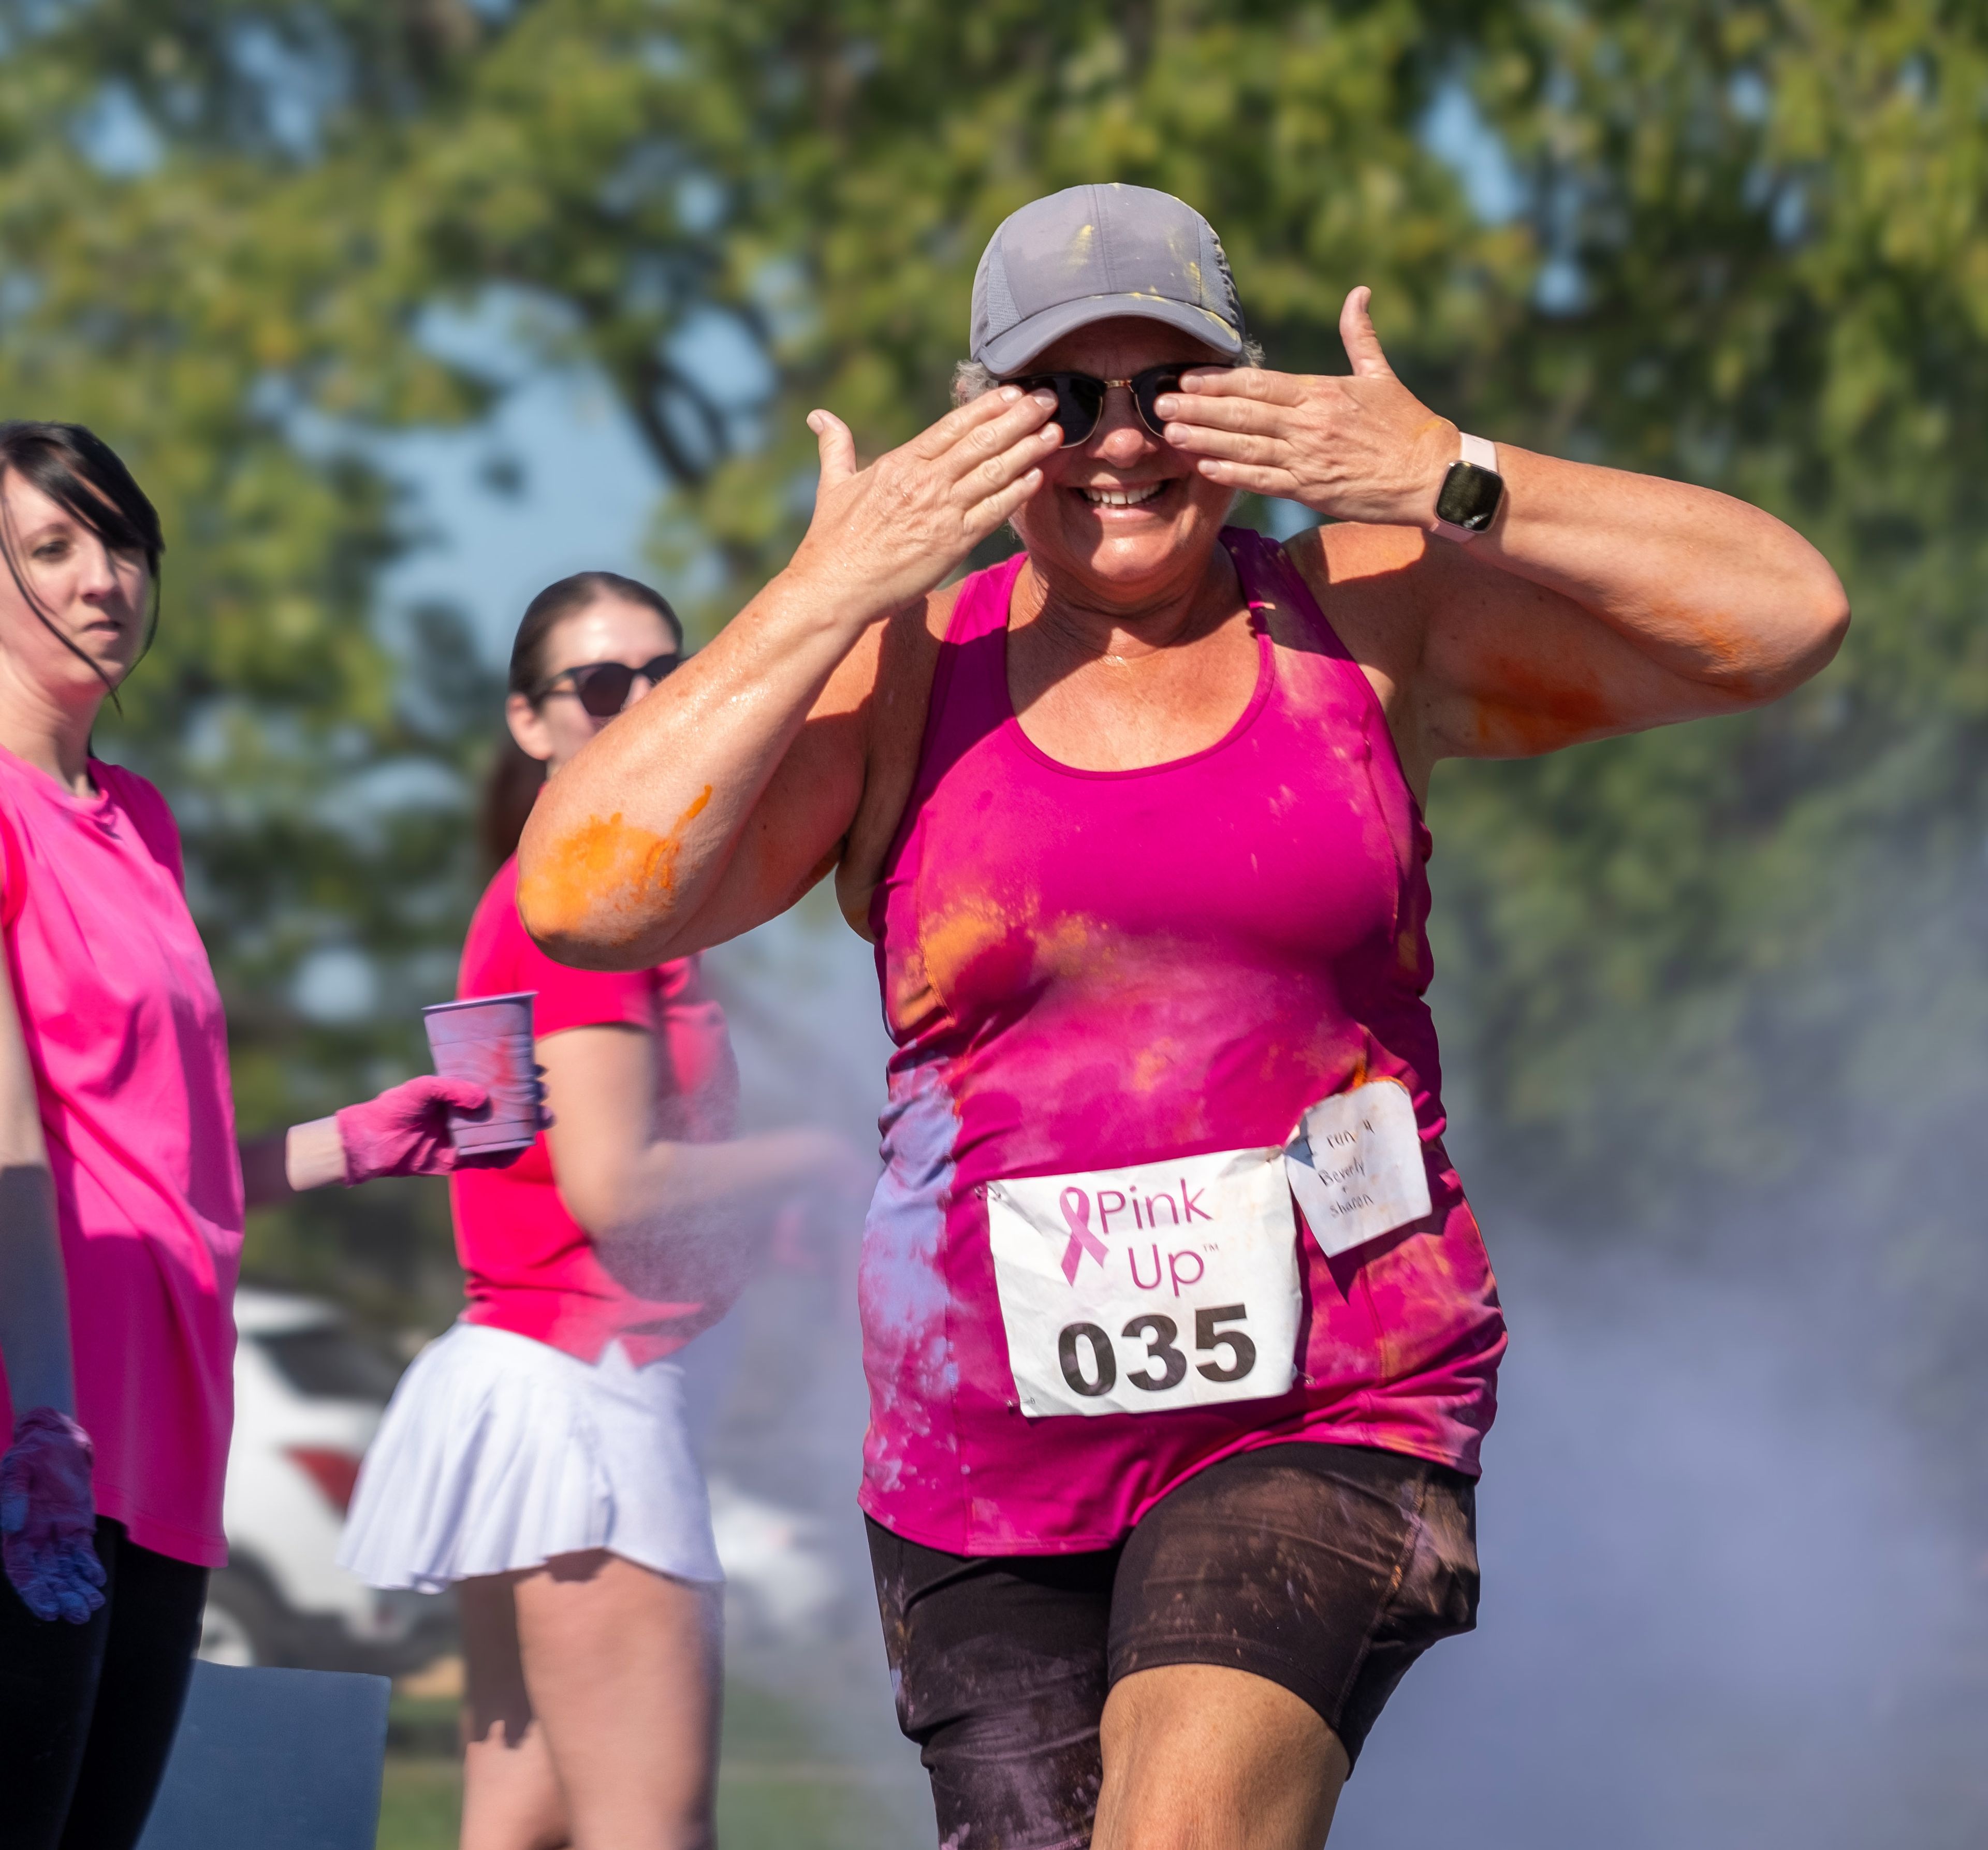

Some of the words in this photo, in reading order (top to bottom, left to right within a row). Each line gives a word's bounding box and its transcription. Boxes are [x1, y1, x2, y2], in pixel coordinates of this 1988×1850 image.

[1326, 1130, 1356, 1149] run
[1318, 1156, 1365, 1187] Beverly
[1097, 1178, 1212, 1234] Pink
[1058, 1302, 1256, 1396] 035
